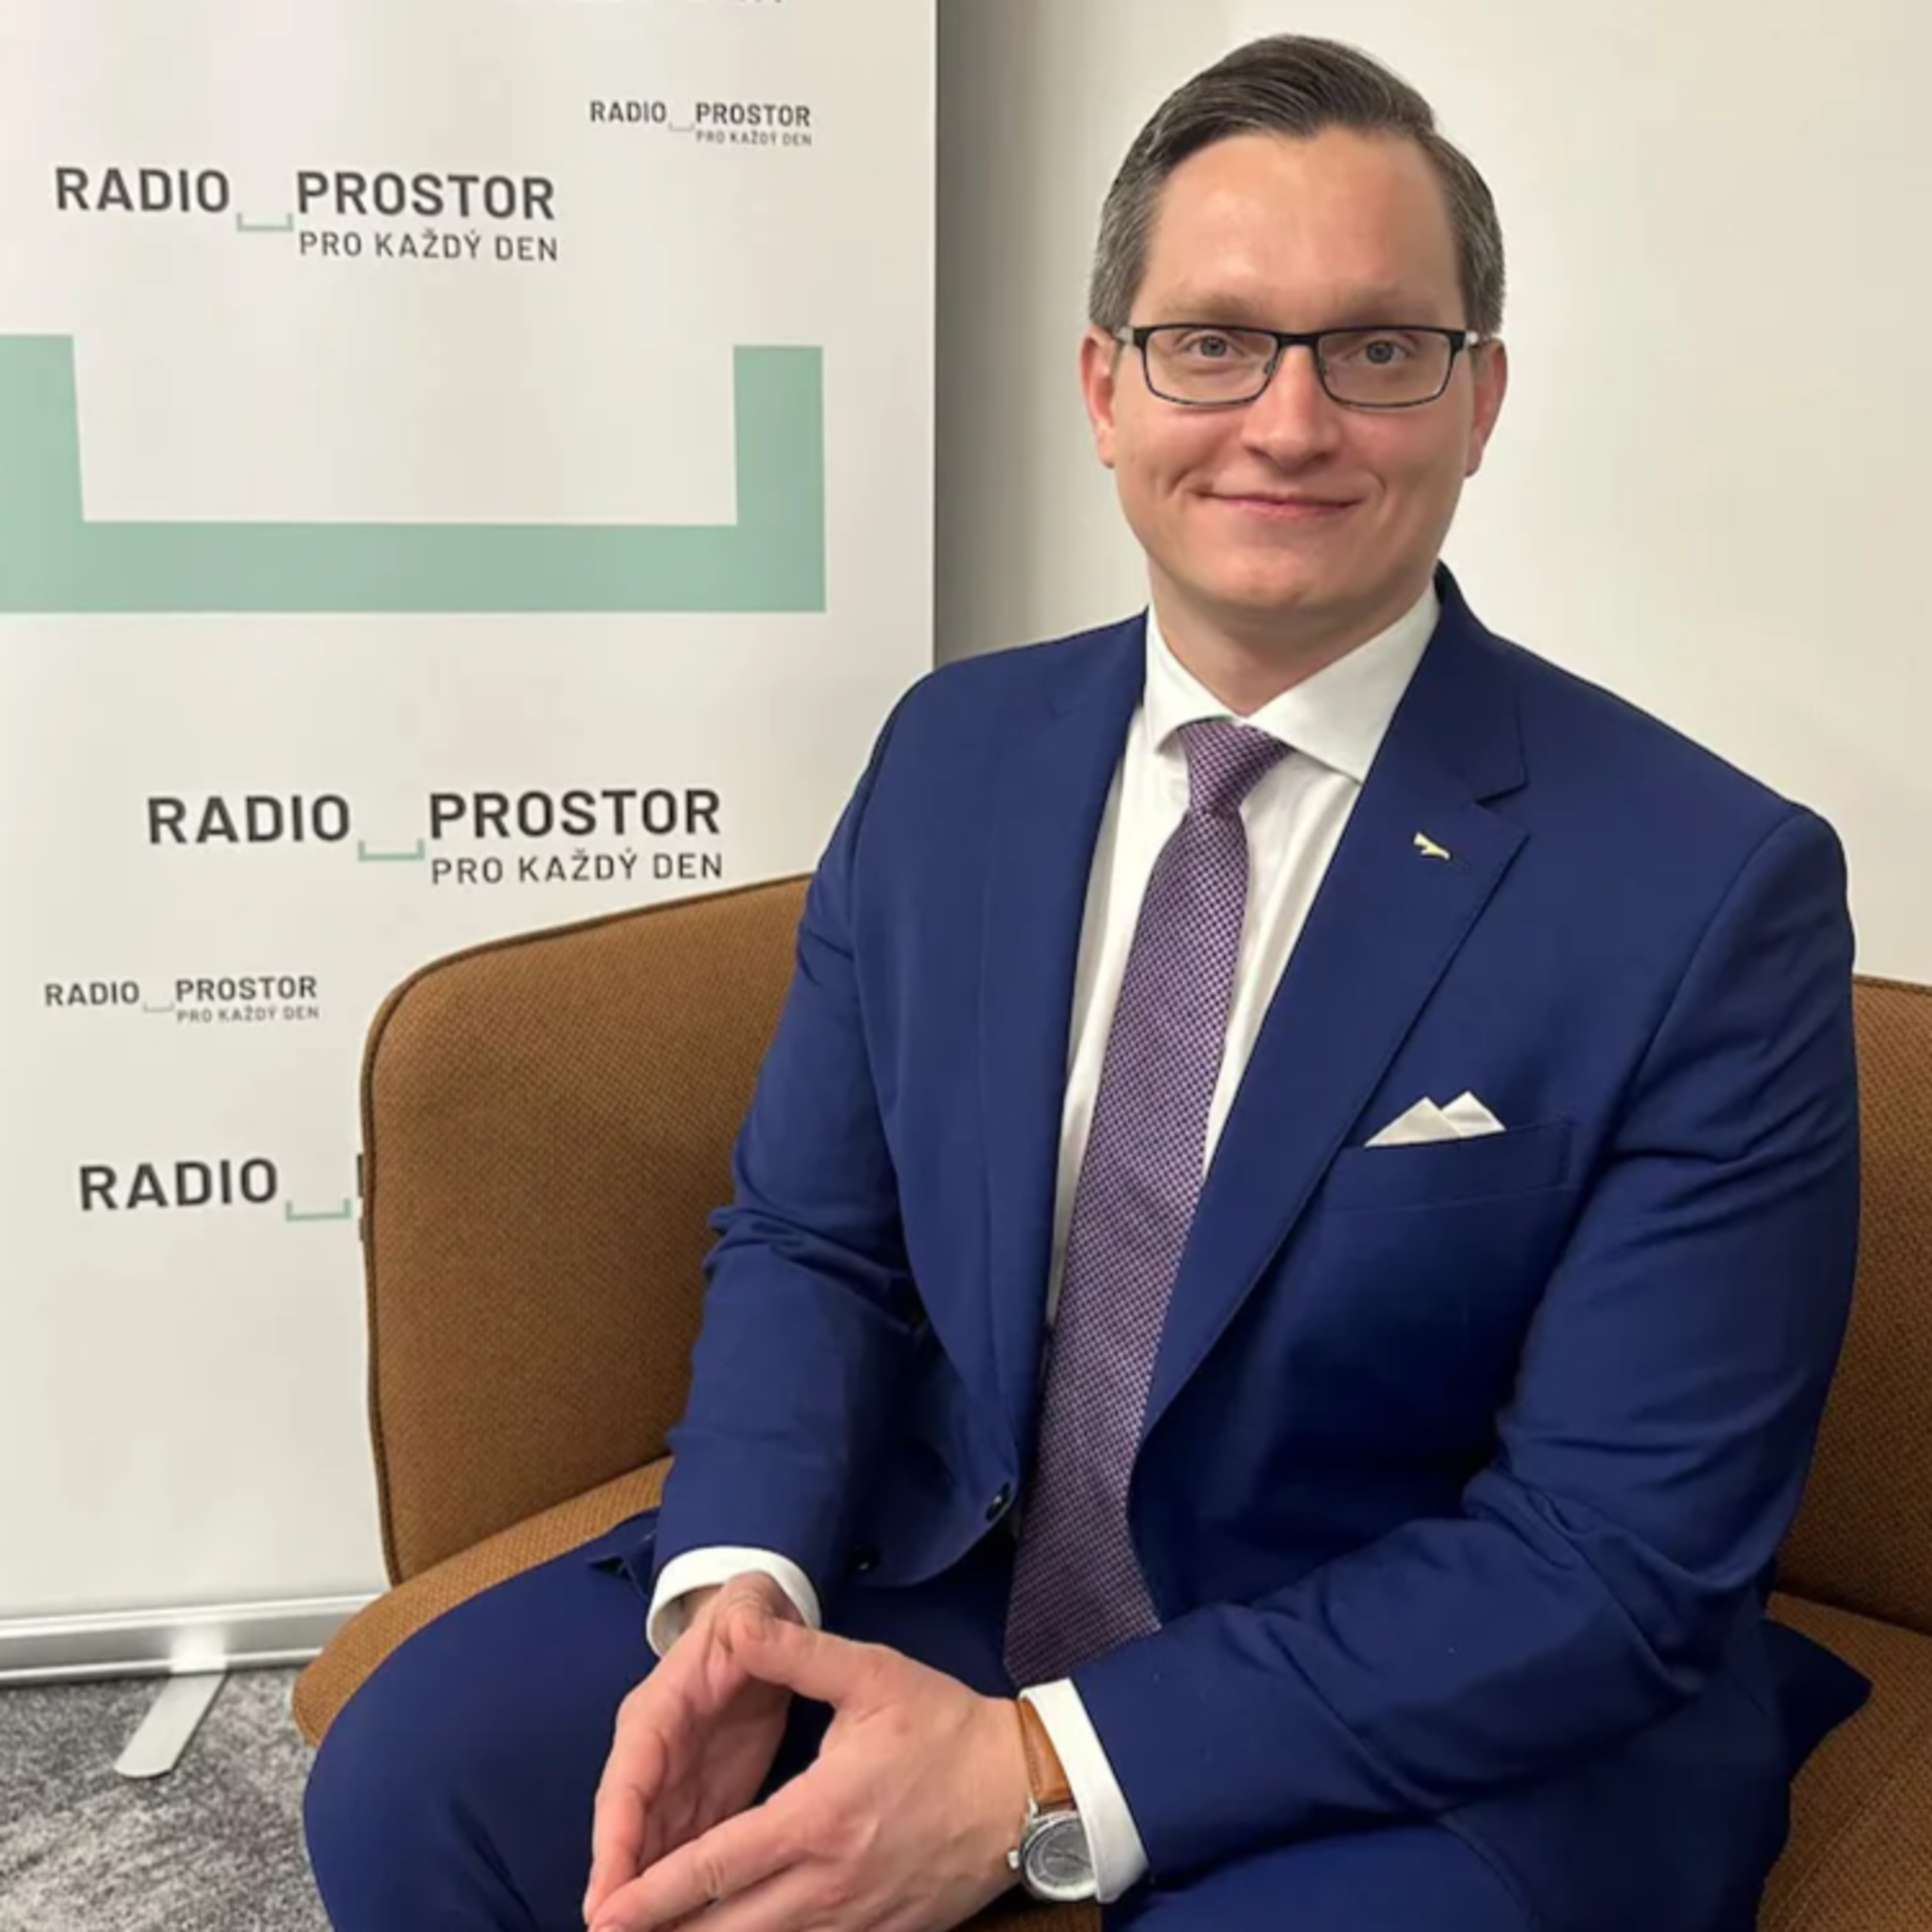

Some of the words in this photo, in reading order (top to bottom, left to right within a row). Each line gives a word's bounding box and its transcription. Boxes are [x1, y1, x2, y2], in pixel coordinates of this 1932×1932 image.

[589, 100, 667, 124] RADIO
[695, 102, 811, 128] PROSTOR
[695, 129, 726, 145] PRO
[782, 132, 812, 147] DEN
[55, 166, 230, 214] RADIO
[296, 170, 555, 221] PROSTOR
[299, 231, 363, 258] PRO
[374, 228, 482, 260] KAŽDÝ
[494, 235, 558, 261] DEN
[147, 793, 350, 846] RADIO
[429, 788, 720, 840] PROSTOR
[431, 857, 504, 886] PRO
[518, 847, 638, 883] KAŽDÝ
[653, 852, 722, 880] DEN
[44, 980, 140, 1007] RADIO
[175, 975, 317, 1003] PROSTOR
[176, 1007, 213, 1024] PRO
[282, 1005, 319, 1021] DEN
[79, 1157, 278, 1212] RADIO
